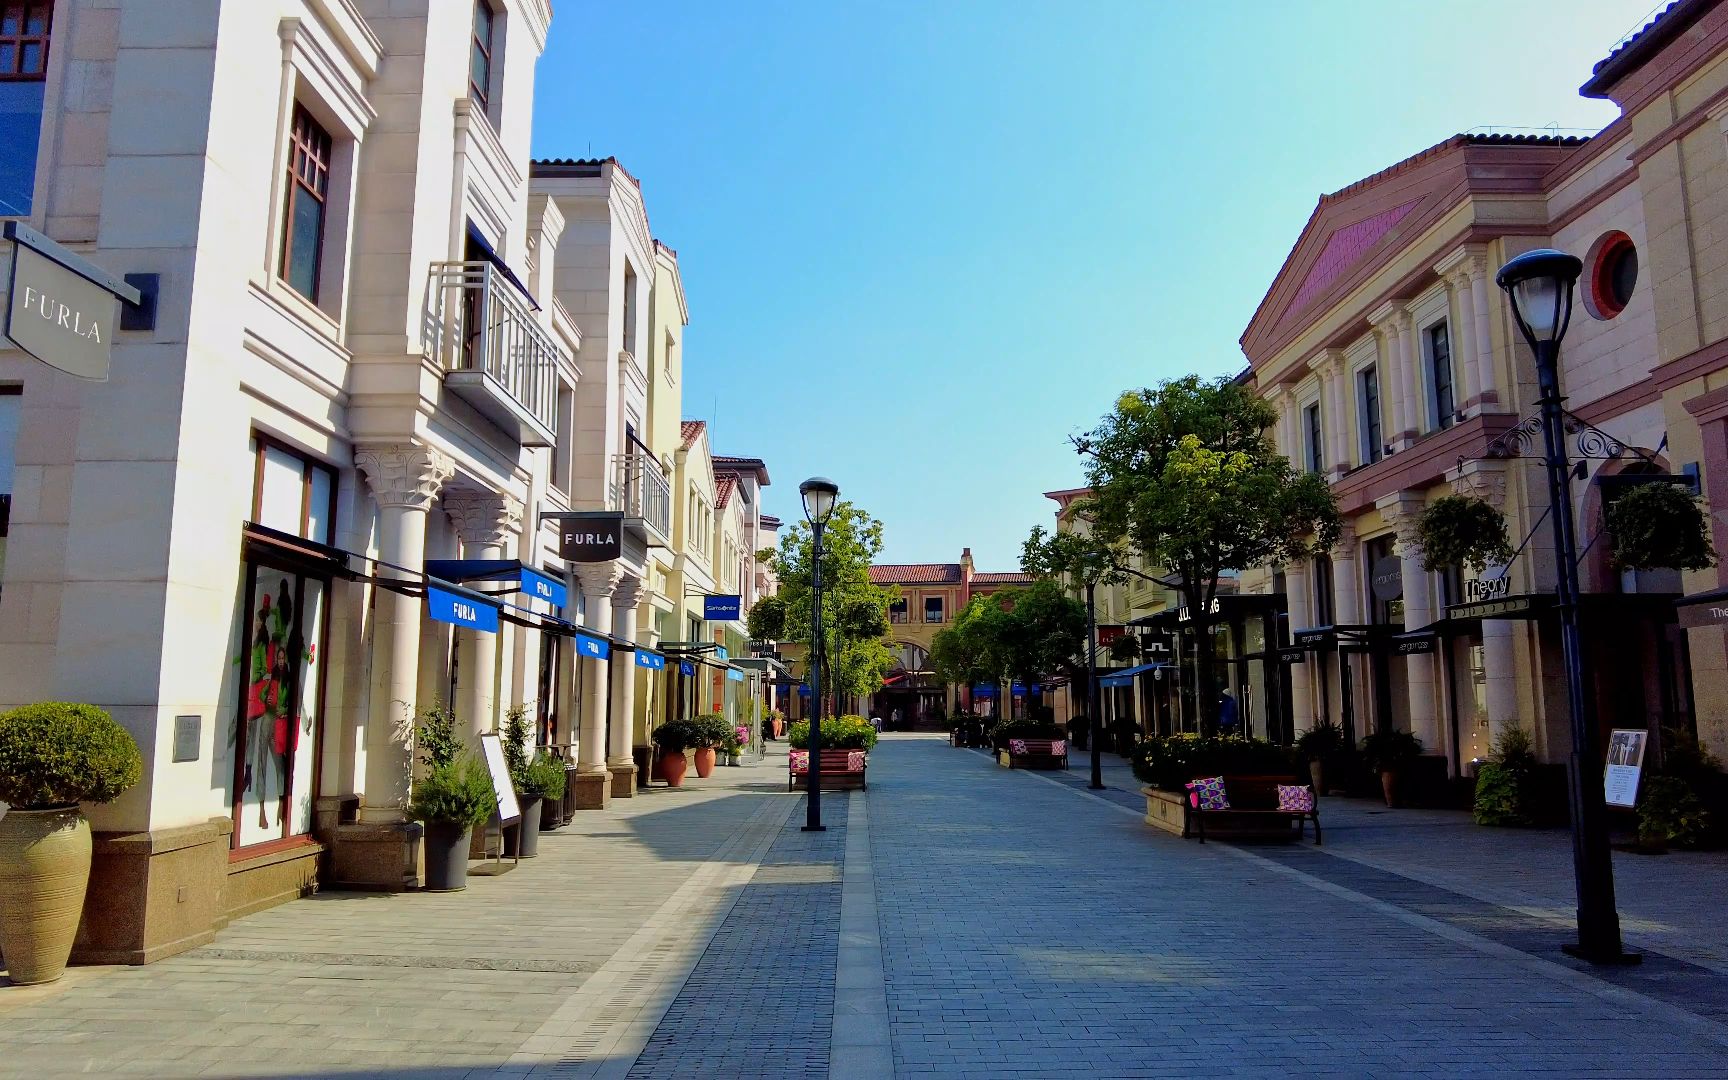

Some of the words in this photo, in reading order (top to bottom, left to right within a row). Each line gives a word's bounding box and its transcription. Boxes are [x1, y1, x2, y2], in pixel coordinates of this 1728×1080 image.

[24, 287, 101, 344] FURLA
[564, 533, 615, 545] FURLA
[1464, 577, 1508, 596] Theory
[453, 602, 477, 622] FURLA
